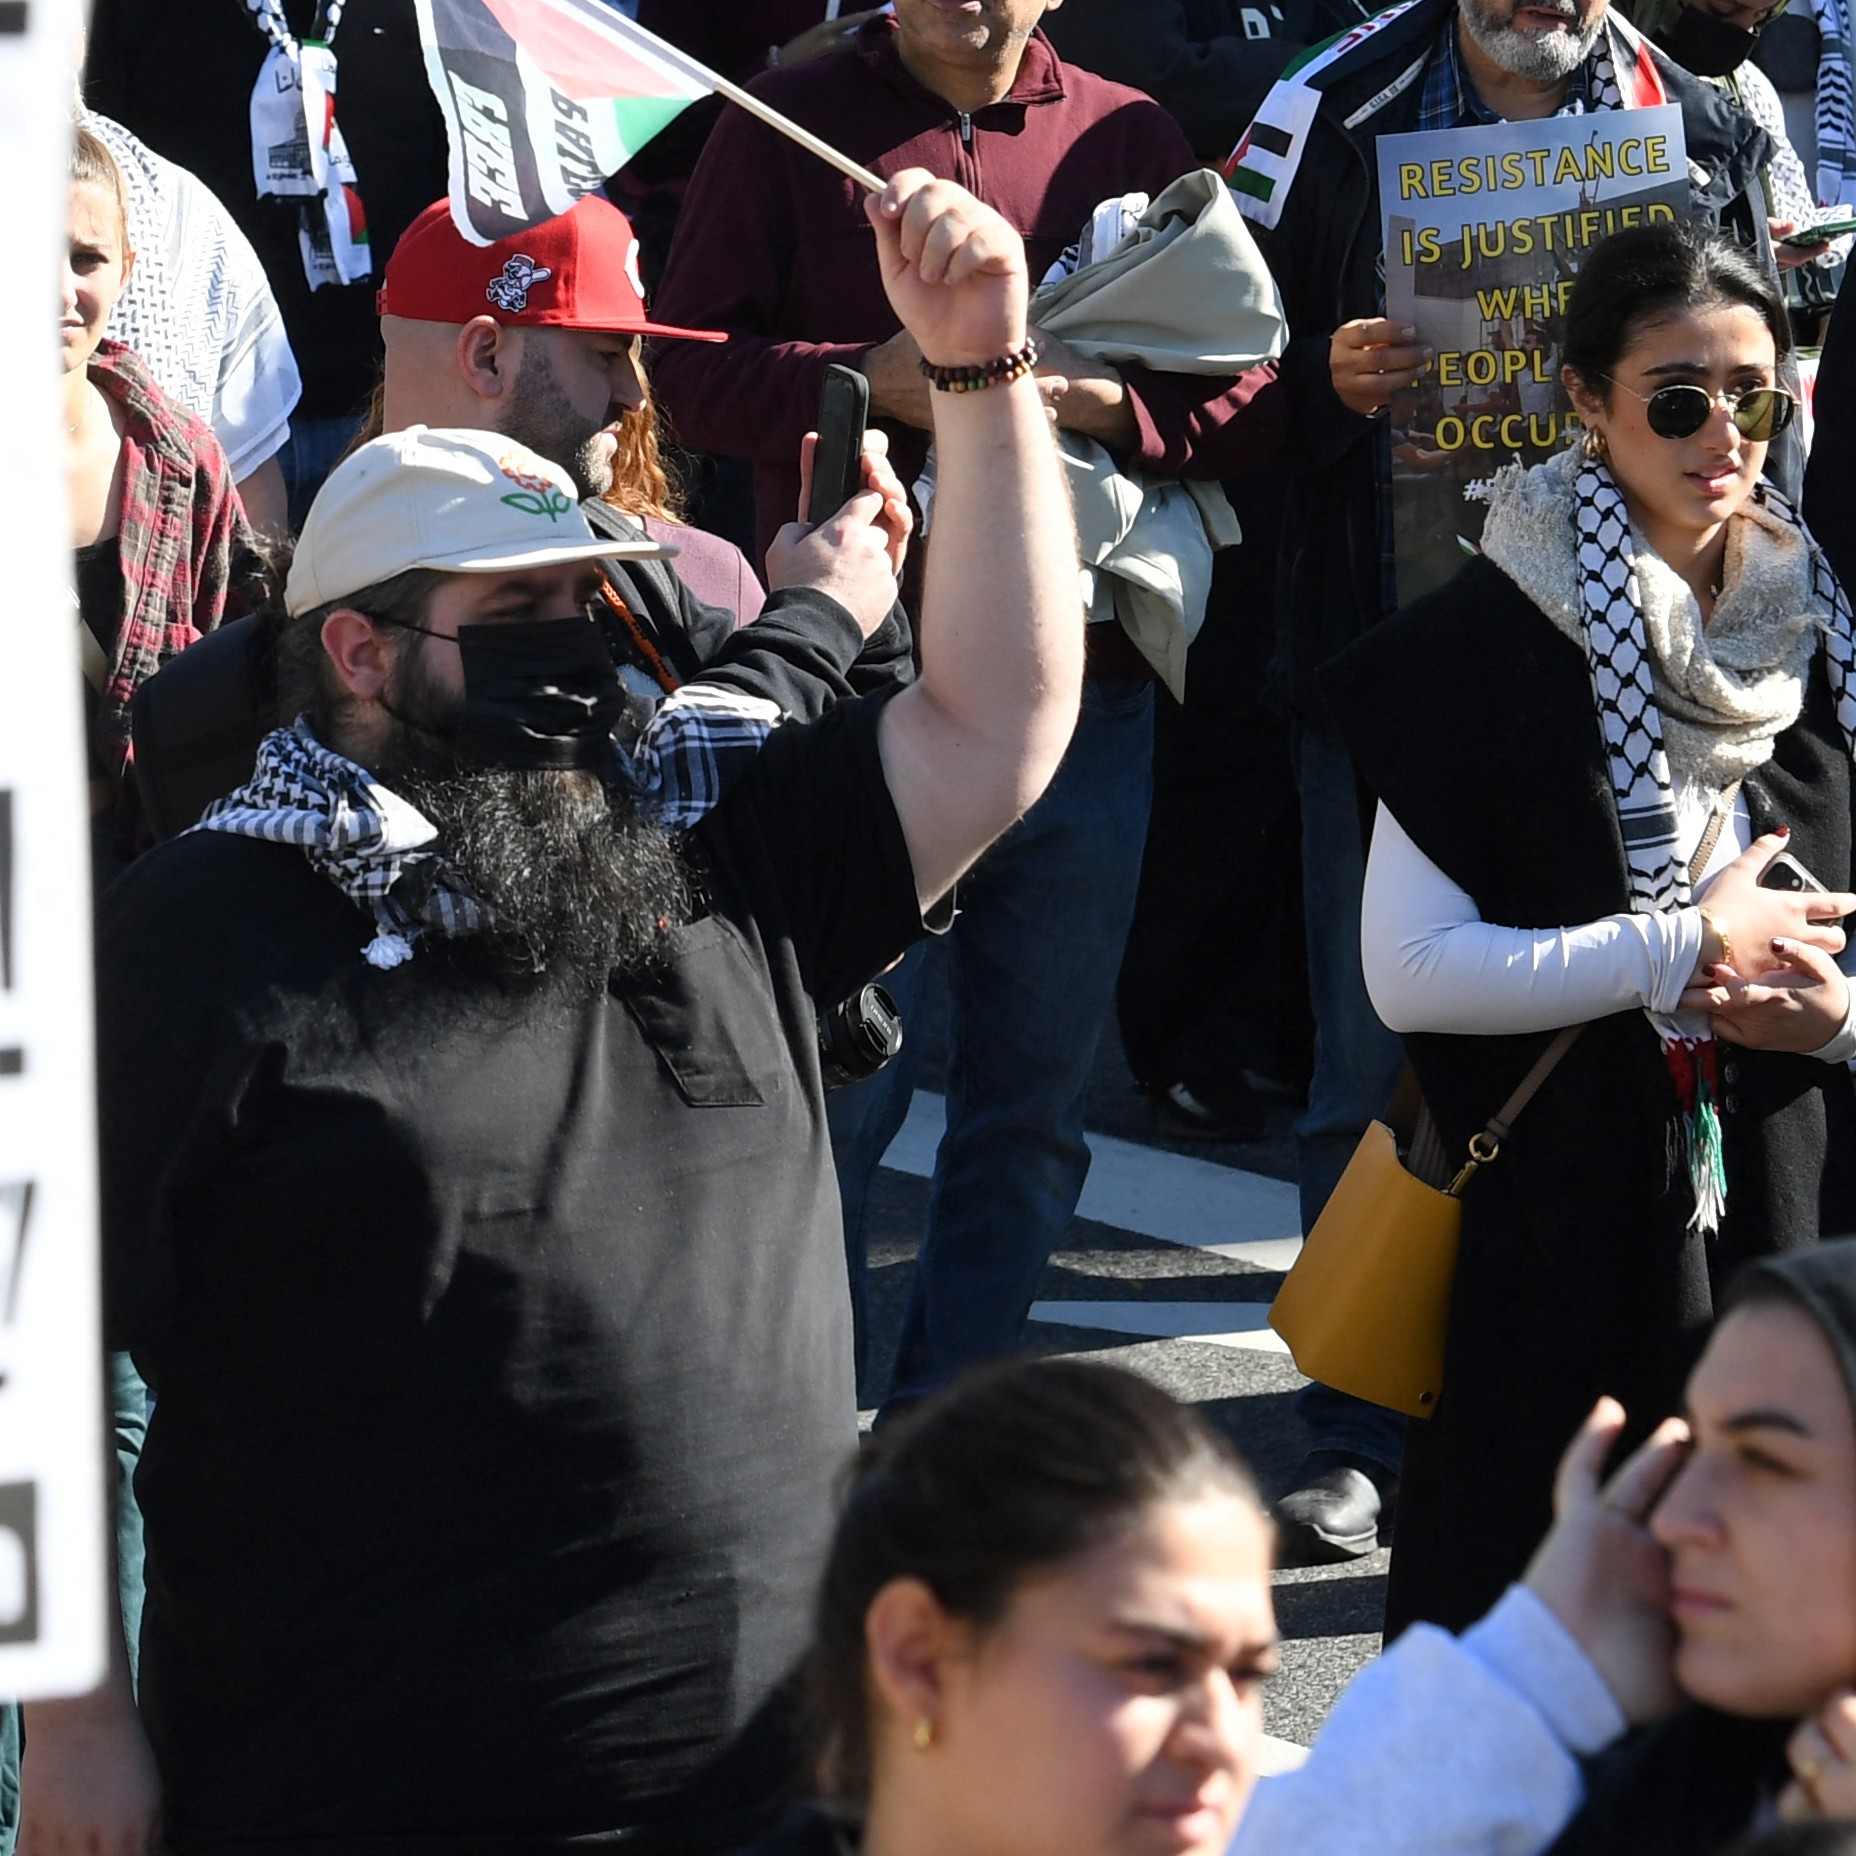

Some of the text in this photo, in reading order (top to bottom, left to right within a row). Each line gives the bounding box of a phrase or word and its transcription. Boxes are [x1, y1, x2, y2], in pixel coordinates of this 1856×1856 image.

[1400, 136, 1671, 200] RESISTANCE
[1401, 227, 1442, 266] IS
[1411, 348, 1554, 388] EOPL
